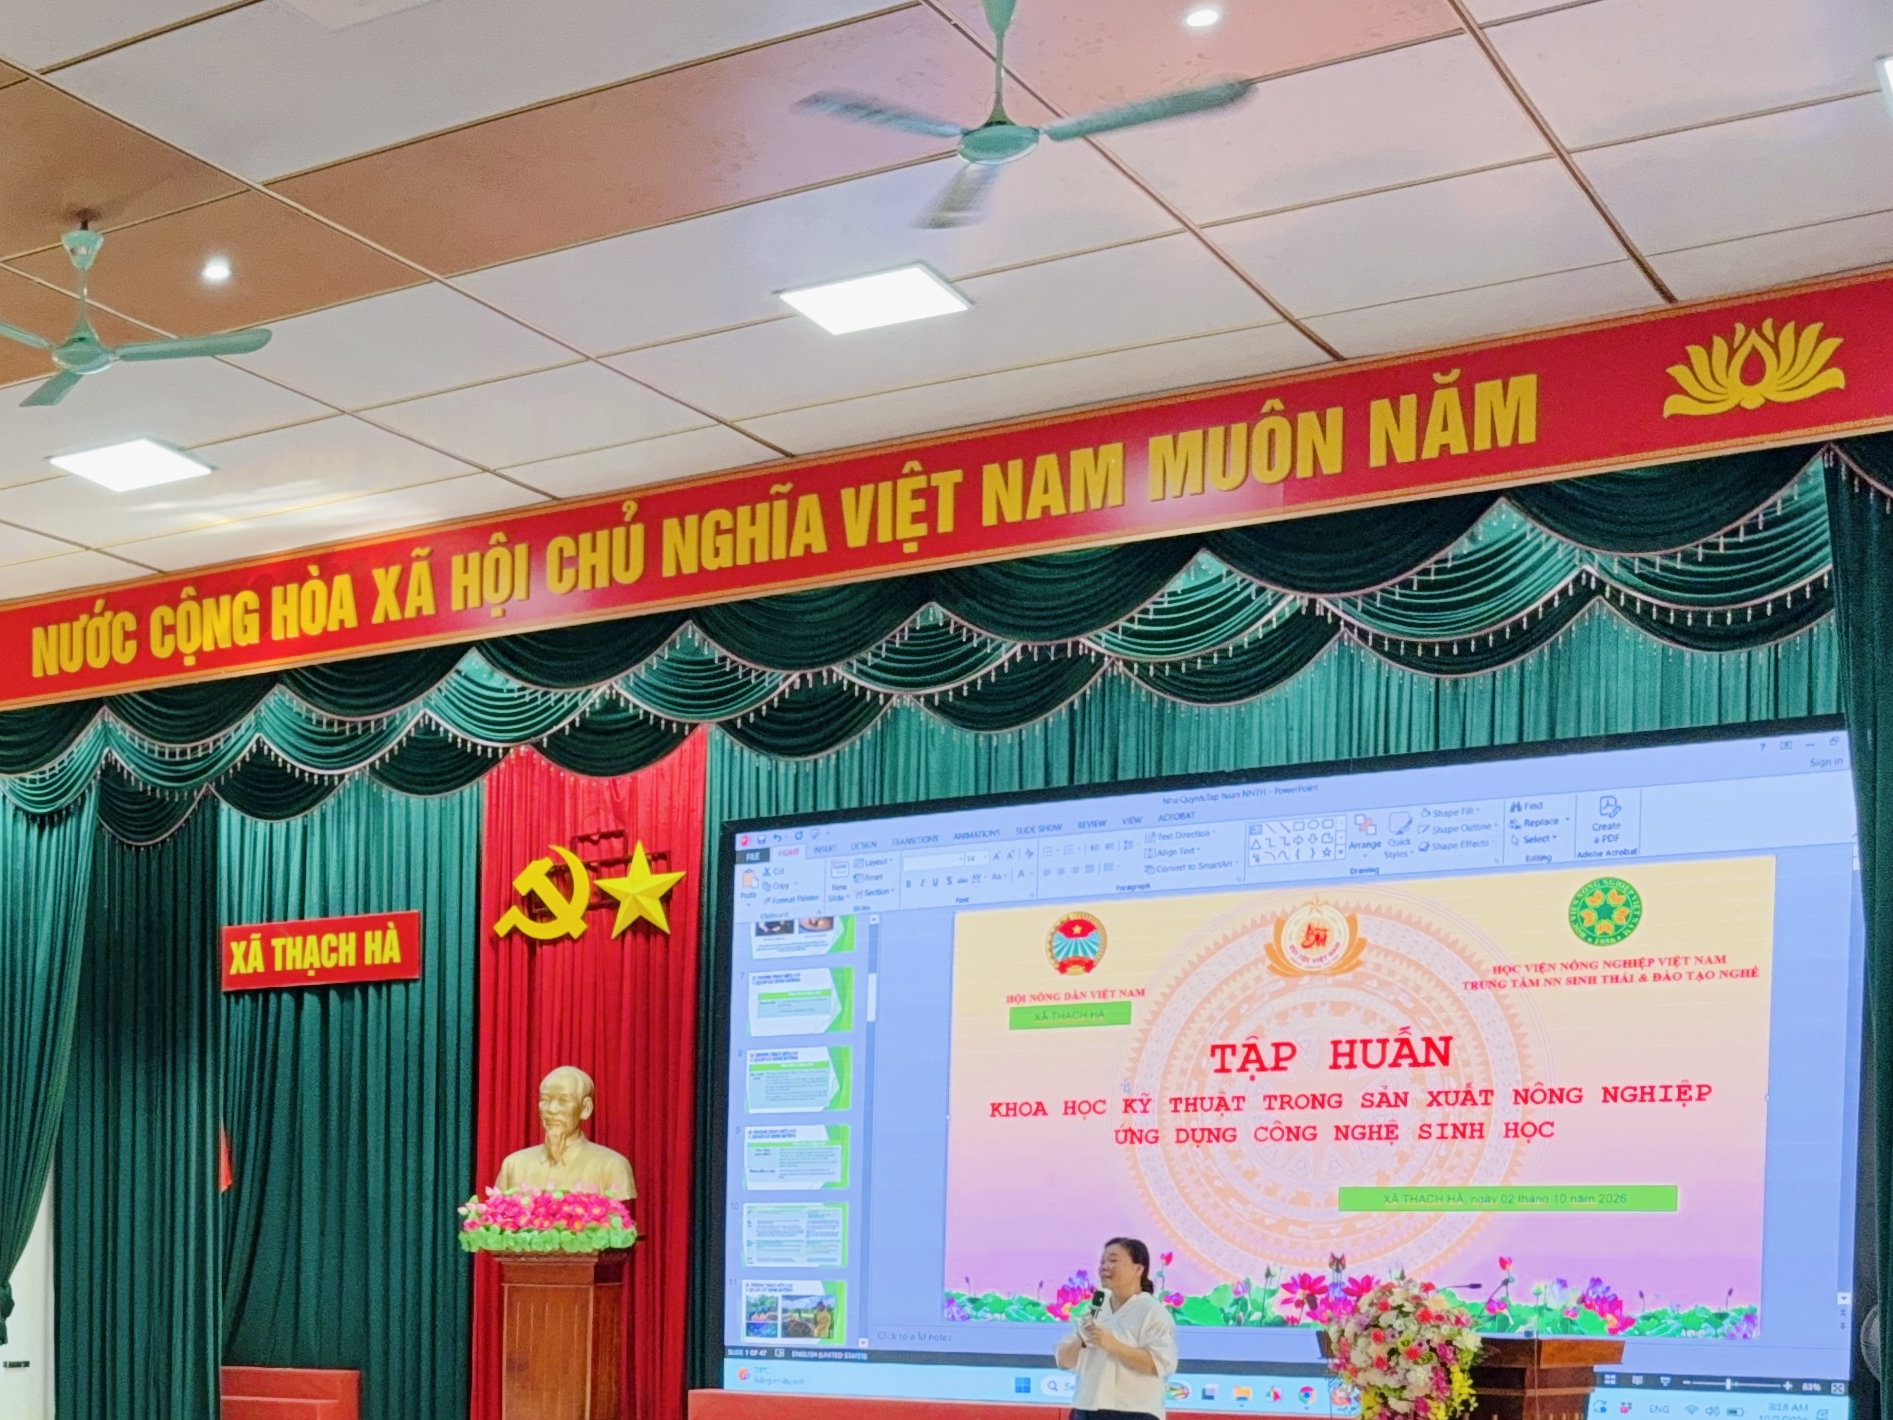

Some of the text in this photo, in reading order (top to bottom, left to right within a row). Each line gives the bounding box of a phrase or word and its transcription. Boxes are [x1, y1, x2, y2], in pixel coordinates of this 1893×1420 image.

[30, 368, 1538, 678] NƯỚC CỘNG HÒA XÃ HỘI CHỦ NGHĨA VIỆT NAM MUÔN NĂM
[1810, 757, 1843, 768] Sign in
[1524, 801, 1544, 810] Find
[1158, 811, 1195, 822] ACROBAT
[1077, 818, 1107, 830] REVIEW
[1524, 817, 1559, 829] Replace
[1592, 822, 1622, 832] Create
[1432, 823, 1493, 835] Shape Outline
[1157, 829, 1210, 842] Text Direction
[1523, 834, 1550, 844] Select
[1601, 834, 1621, 843] PDF
[1349, 840, 1382, 850] Arrange
[1387, 837, 1412, 847] Quick
[777, 848, 800, 857] HOME
[1576, 848, 1638, 859] Adobe Acrobat
[229, 921, 401, 977] XÃ THẠCH HÀ
[1492, 954, 1727, 977] HỌC VIỆN NÔNG NGHIỆP VIỆT NAM
[1462, 979, 1507, 991] TRUNG
[1510, 976, 1540, 989] TÂM
[1542, 976, 1562, 988] NN
[1565, 974, 1598, 986] SINH
[1601, 972, 1634, 985] THÁI
[1638, 973, 1648, 983] &
[1652, 970, 1683, 983] ĐÀO
[1686, 969, 1716, 983] TẠO
[1006, 987, 1146, 1005] HỘI NÔNG DÂN VIỆT NAM
[1090, 1007, 1106, 1019] HÀ
[1209, 1026, 1453, 1082] TẬP HUẤN
[989, 1079, 1713, 1121] KHOA HỌC KỸ THUẬT TRONG SẢN XUẤT NÔNG NGHIỆP
[1114, 1118, 1555, 1149] ỨNG DỤNG CÔNG NGHỆ SINH HỌC
[1500, 1193, 1516, 1204] 02
[1554, 1193, 1567, 1204] 10
[1569, 1193, 1595, 1204] năm
[1598, 1193, 1628, 1204] 2026
[730, 1202, 739, 1211] 10
[729, 1278, 738, 1287] 11
[1649, 1404, 1670, 1414] ENG
[1768, 1402, 1809, 1413] 8:18 AM
